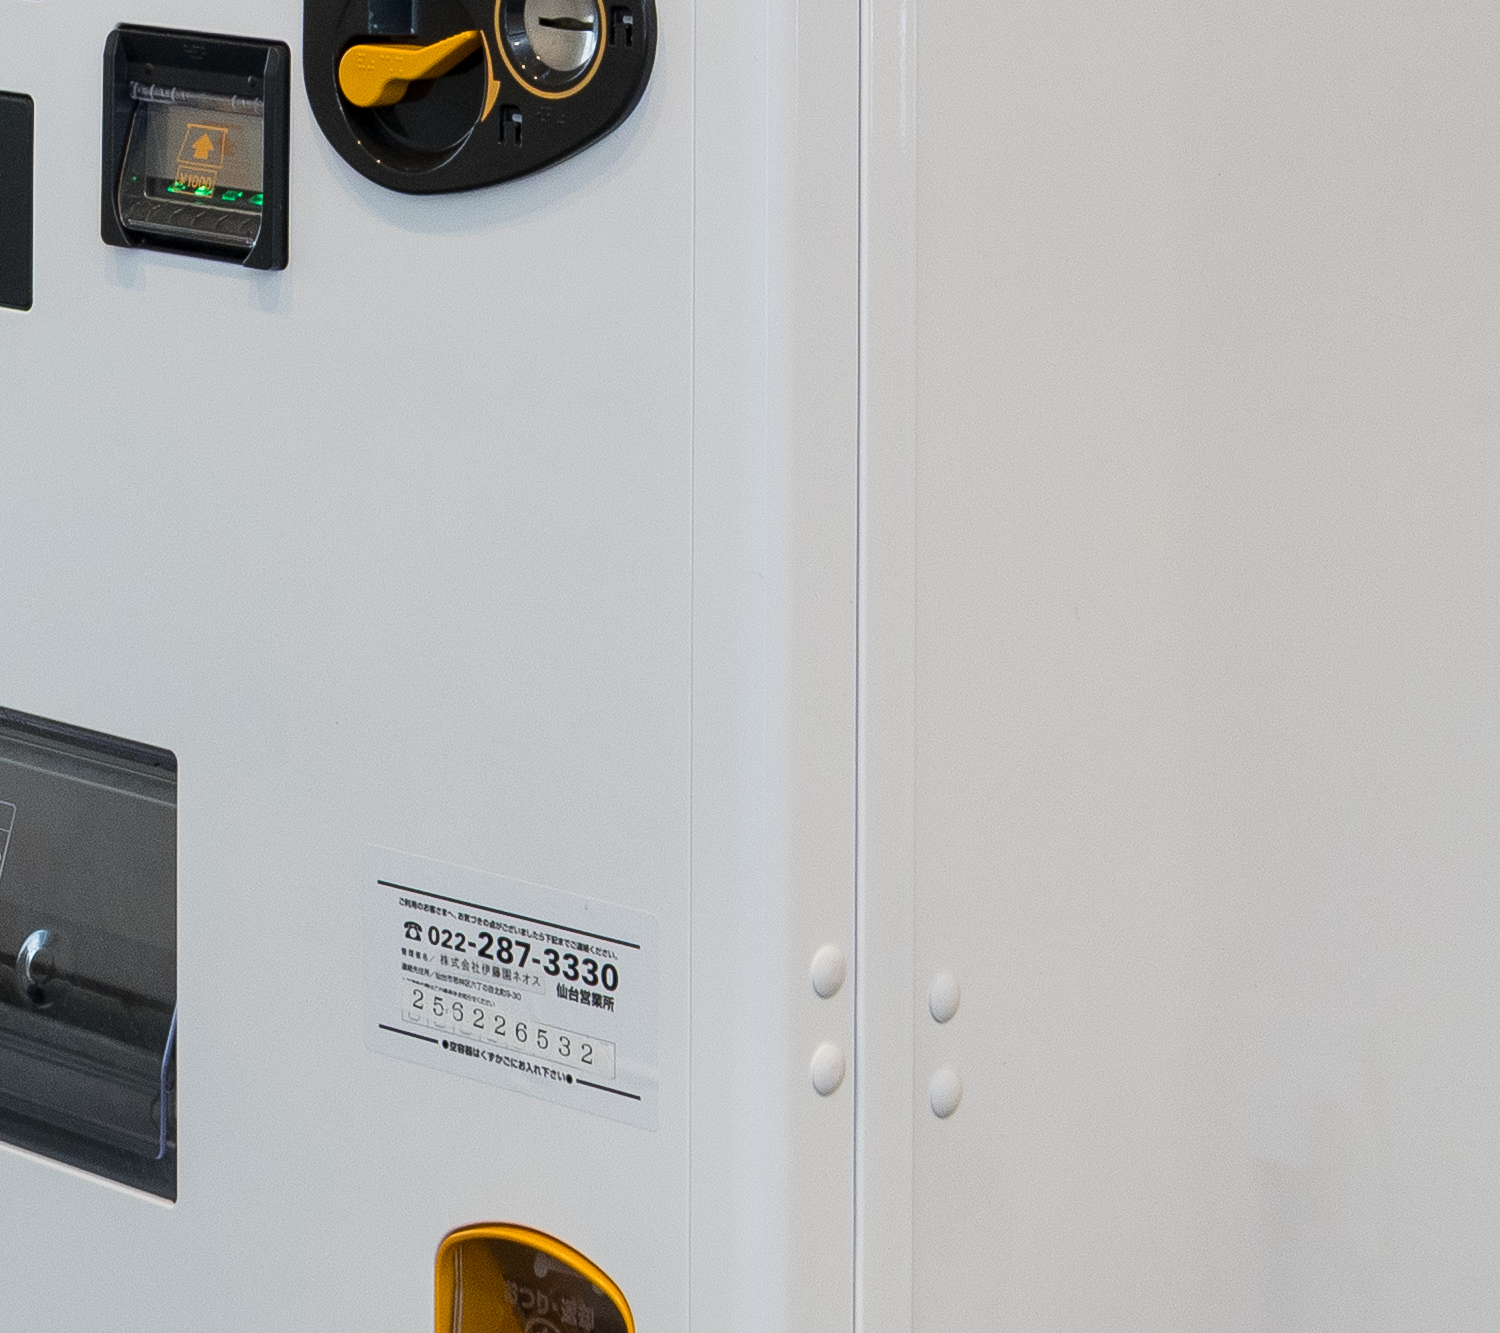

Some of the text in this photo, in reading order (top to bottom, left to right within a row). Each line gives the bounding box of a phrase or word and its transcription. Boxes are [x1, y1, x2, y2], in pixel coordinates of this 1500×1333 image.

[427, 925, 619, 992] 022-287-3330
[556, 982, 615, 1013] 仙台営業所
